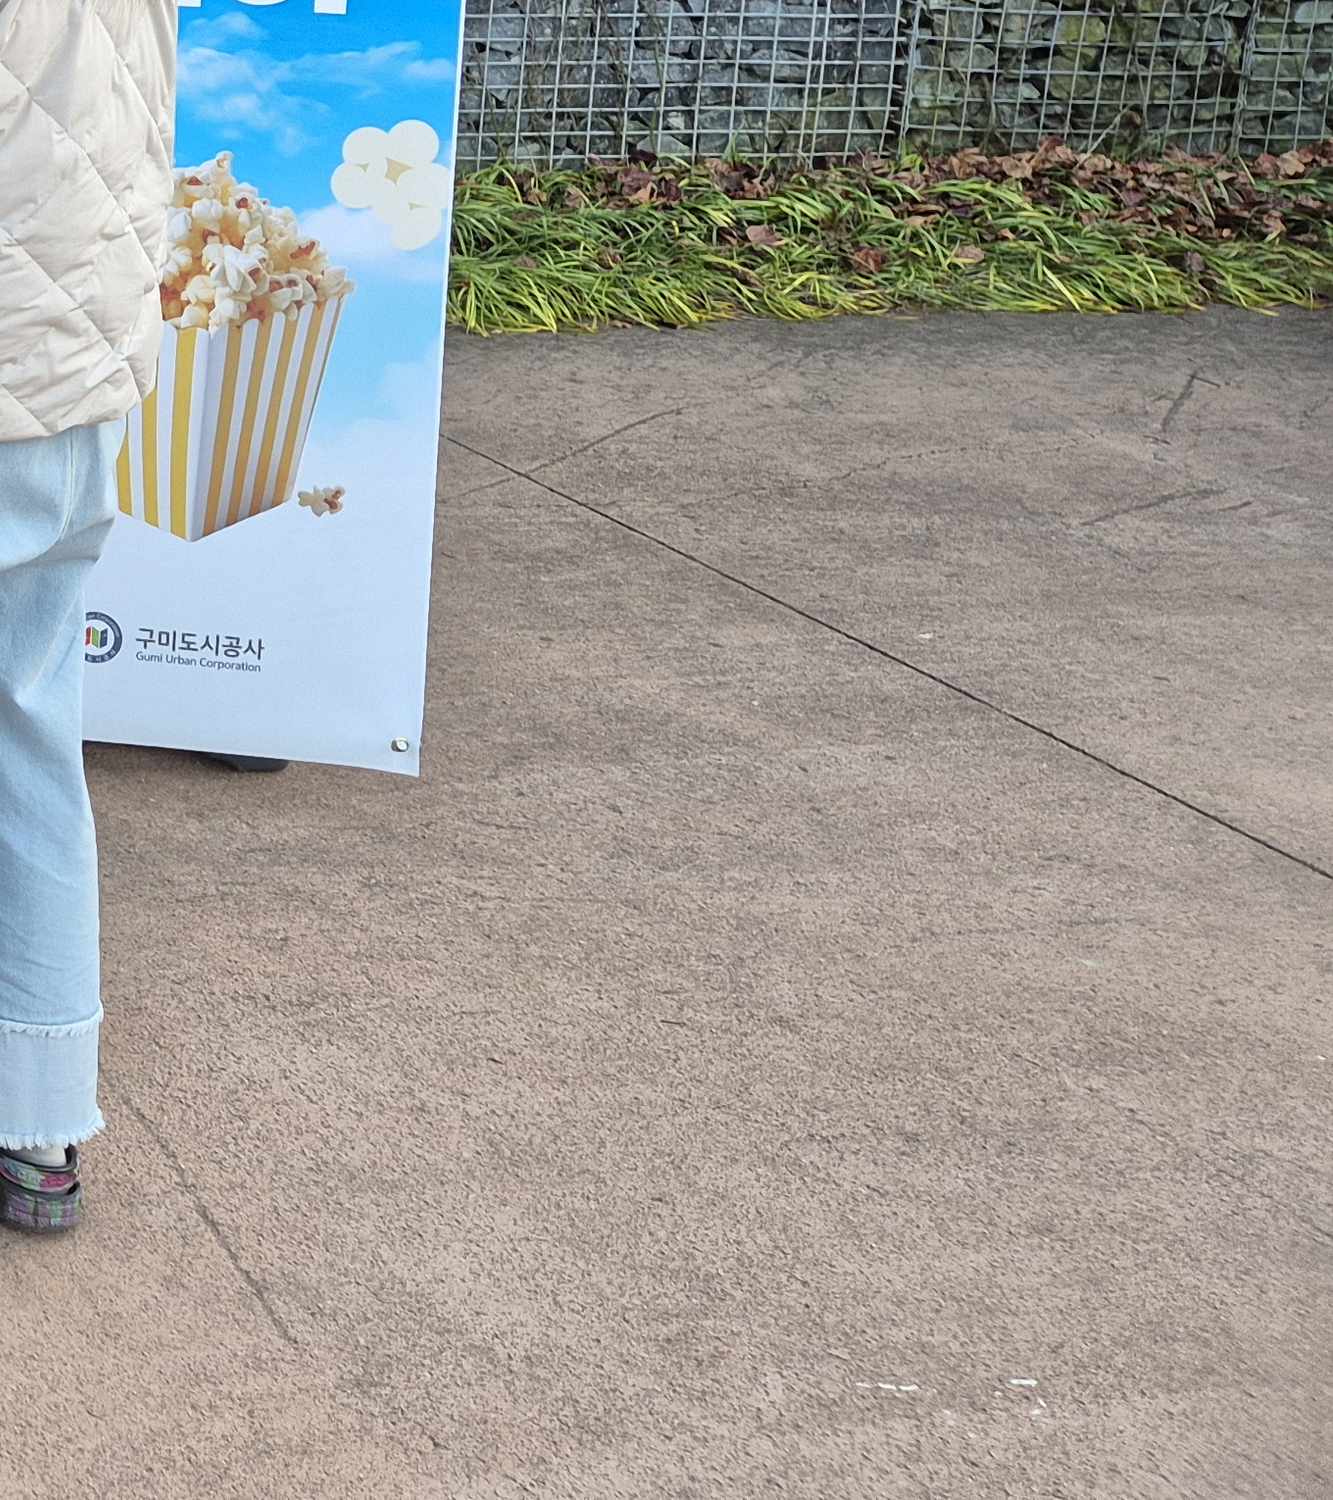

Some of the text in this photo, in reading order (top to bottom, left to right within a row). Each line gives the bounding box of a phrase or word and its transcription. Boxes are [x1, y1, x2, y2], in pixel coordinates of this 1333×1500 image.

[135, 627, 265, 661] 구미도시공사
[135, 651, 261, 673] Gumi Urban Corporation
